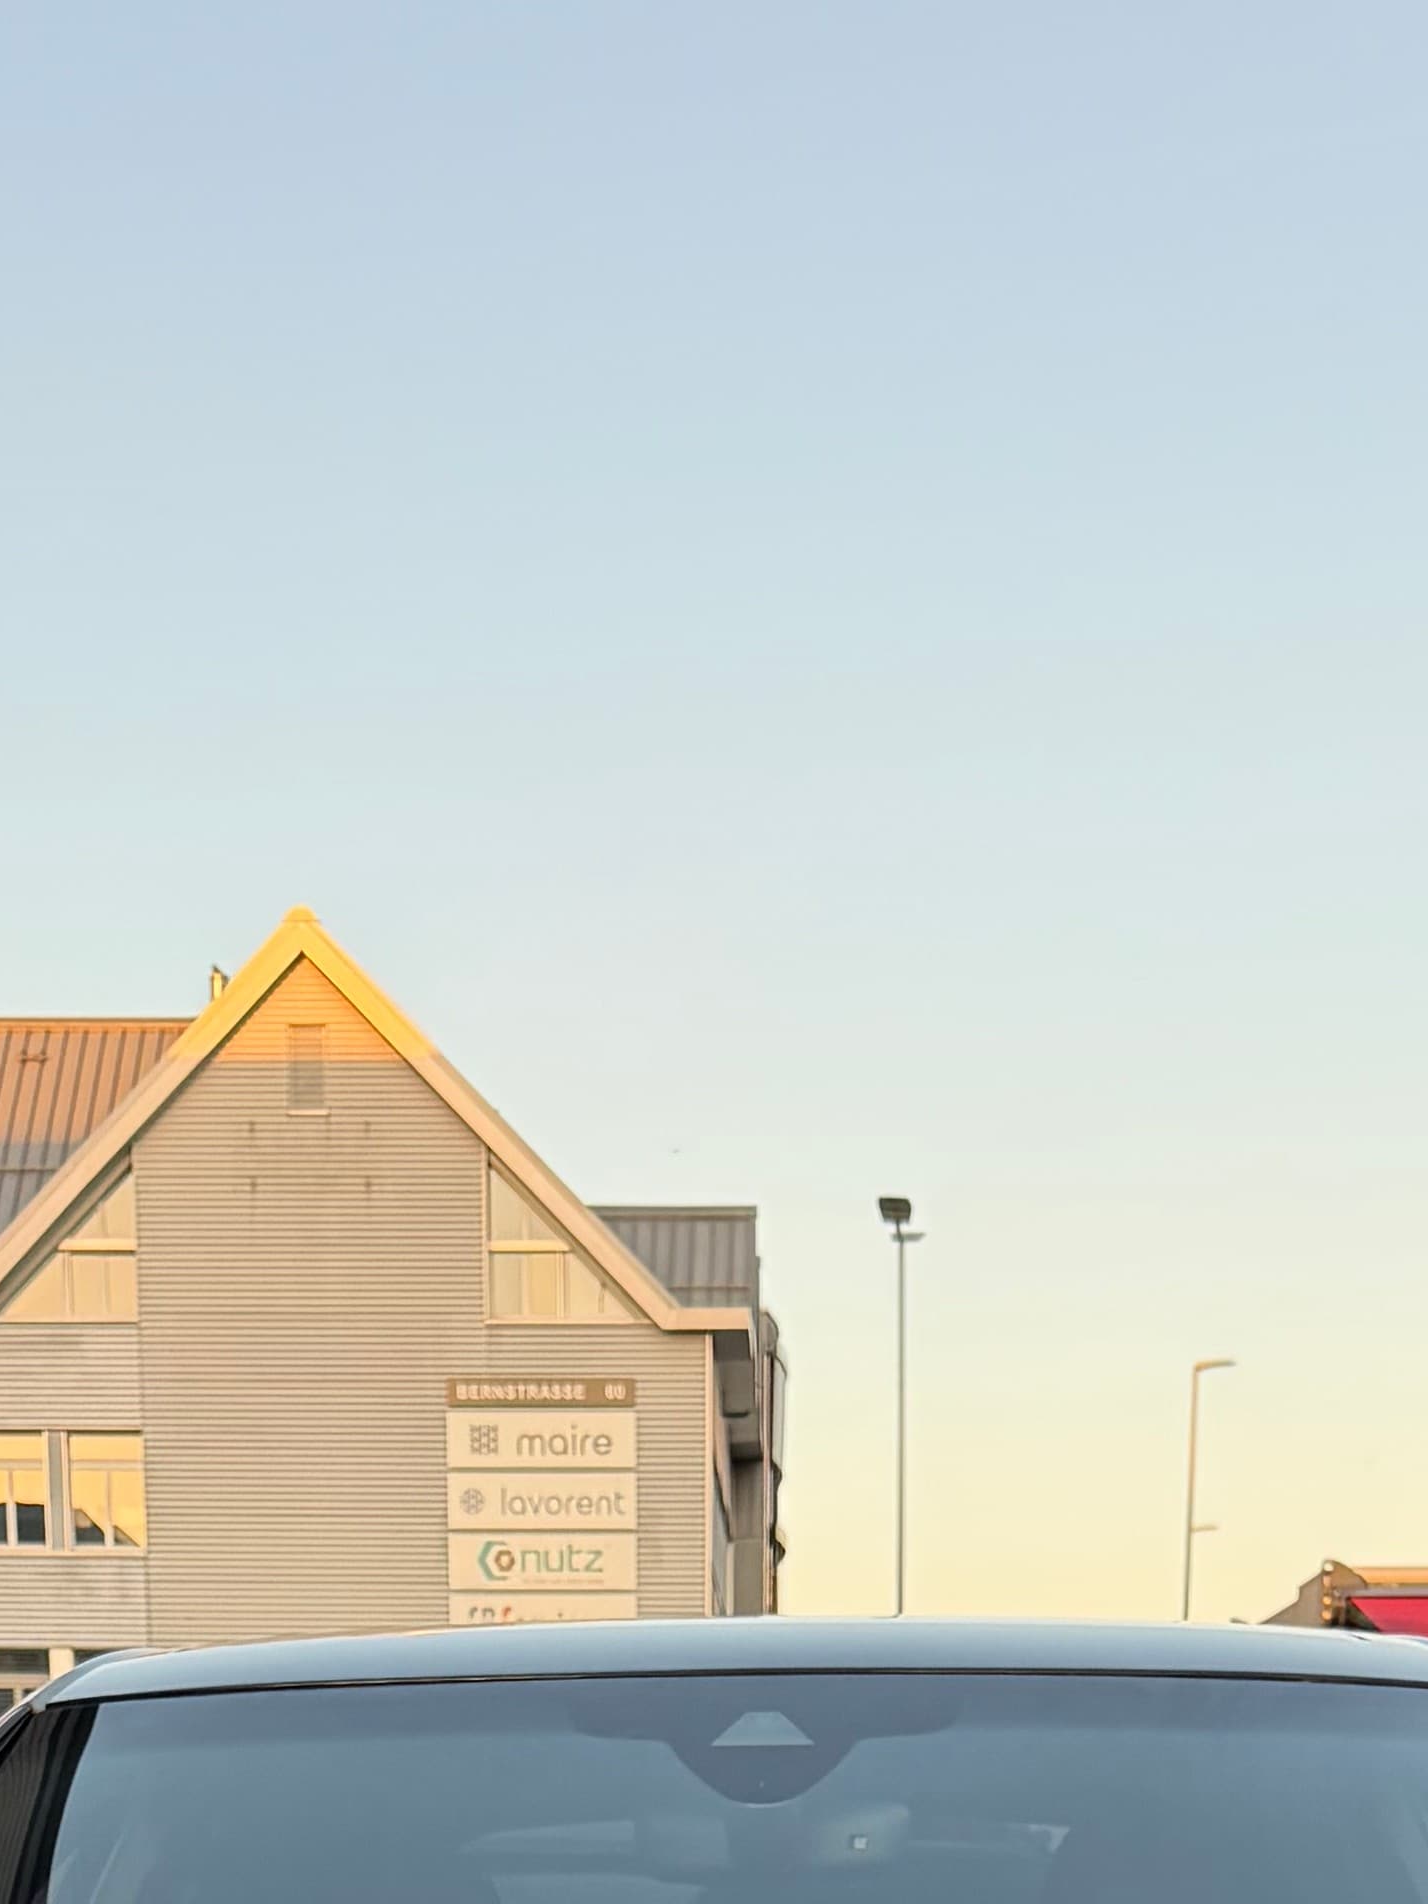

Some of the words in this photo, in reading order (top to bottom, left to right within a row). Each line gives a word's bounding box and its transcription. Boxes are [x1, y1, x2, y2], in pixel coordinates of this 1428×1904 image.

[455, 1383, 586, 1401] BERNSTRASSE
[515, 1424, 614, 1457] maire
[500, 1487, 626, 1516] lavorent
